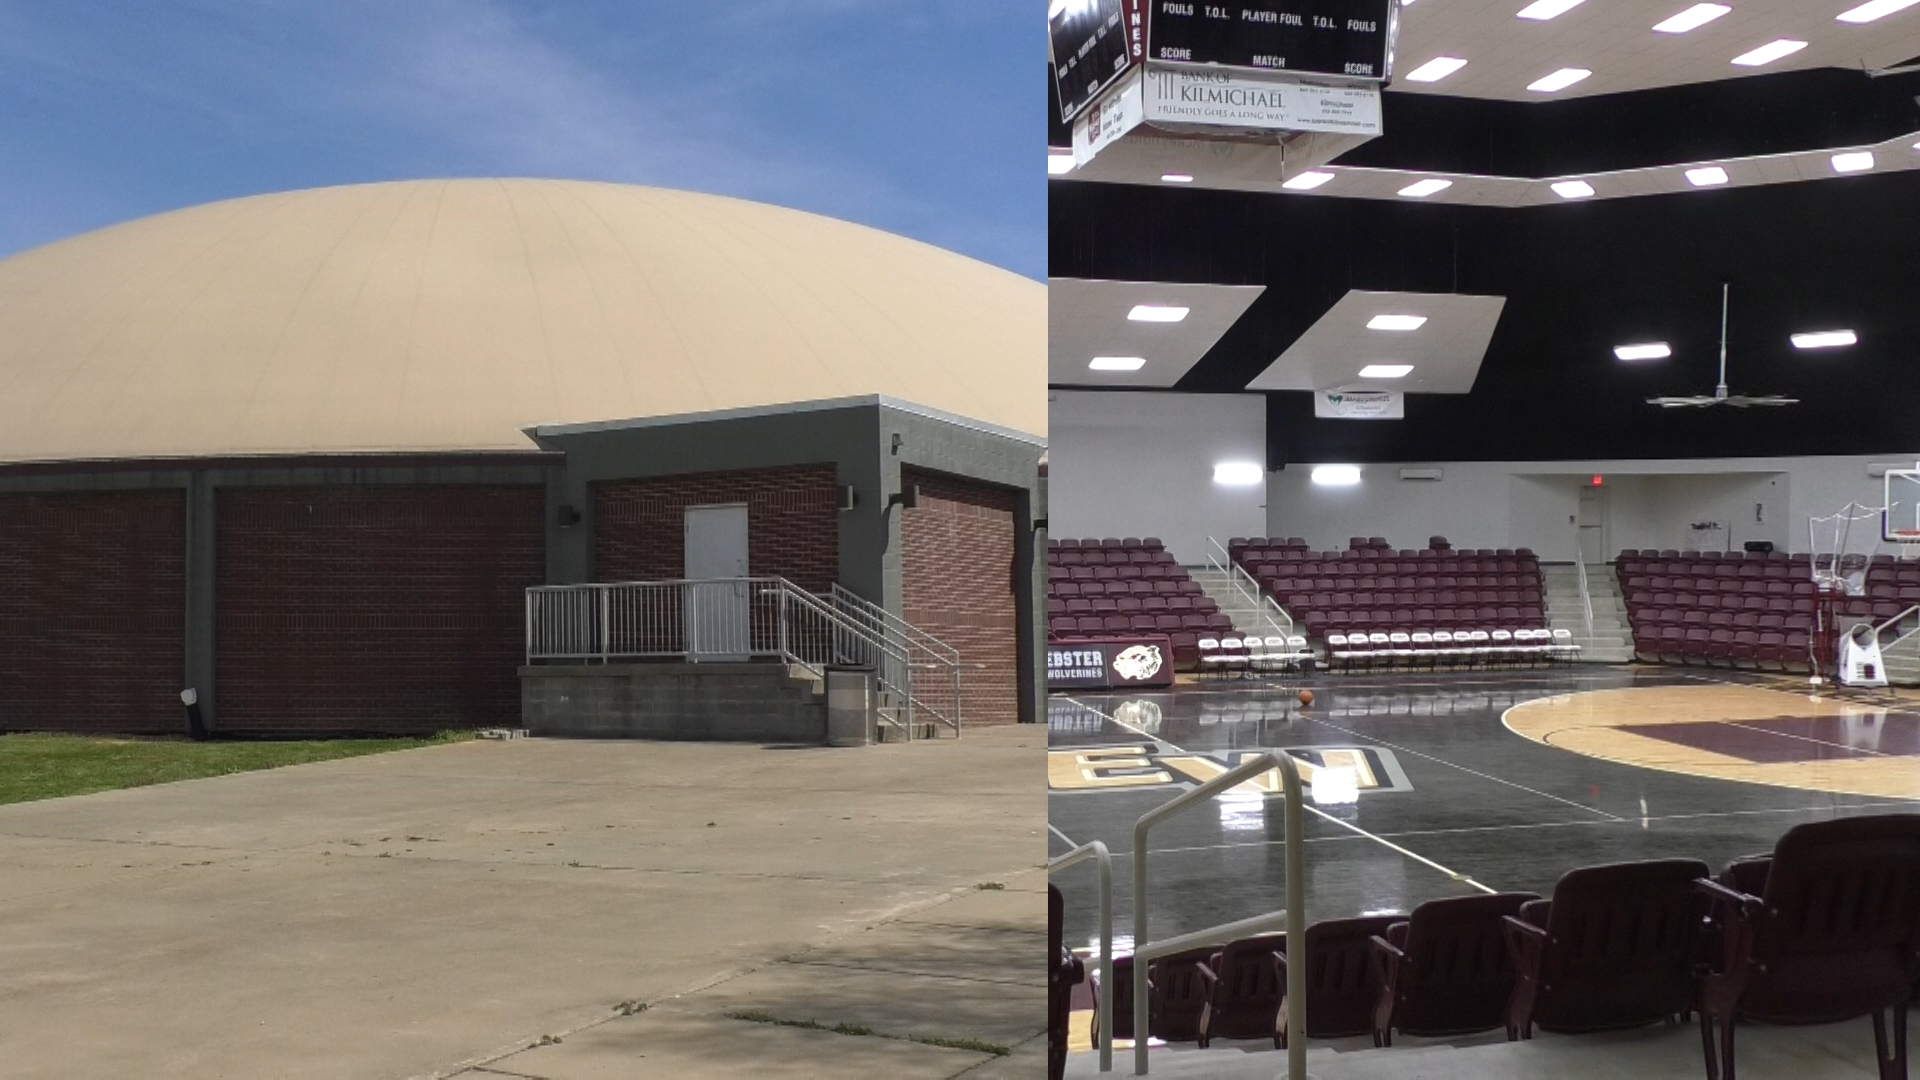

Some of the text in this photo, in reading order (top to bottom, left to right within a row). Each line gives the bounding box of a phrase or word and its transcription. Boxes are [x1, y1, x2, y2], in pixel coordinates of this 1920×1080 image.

[1163, 2, 1377, 32] FOULS T.O.L. PLAYER FOUL T.O.L. FOULS
[1161, 46, 1374, 75] SCORE MATCH SCORE
[1181, 69, 1231, 84] BANK OF
[1181, 85, 1286, 108] KILMICHAEL
[1158, 105, 1202, 116] FRIENDLY
[1204, 108, 1227, 118] GOES
[1228, 109, 1236, 118] A
[1238, 111, 1265, 120] LONG
